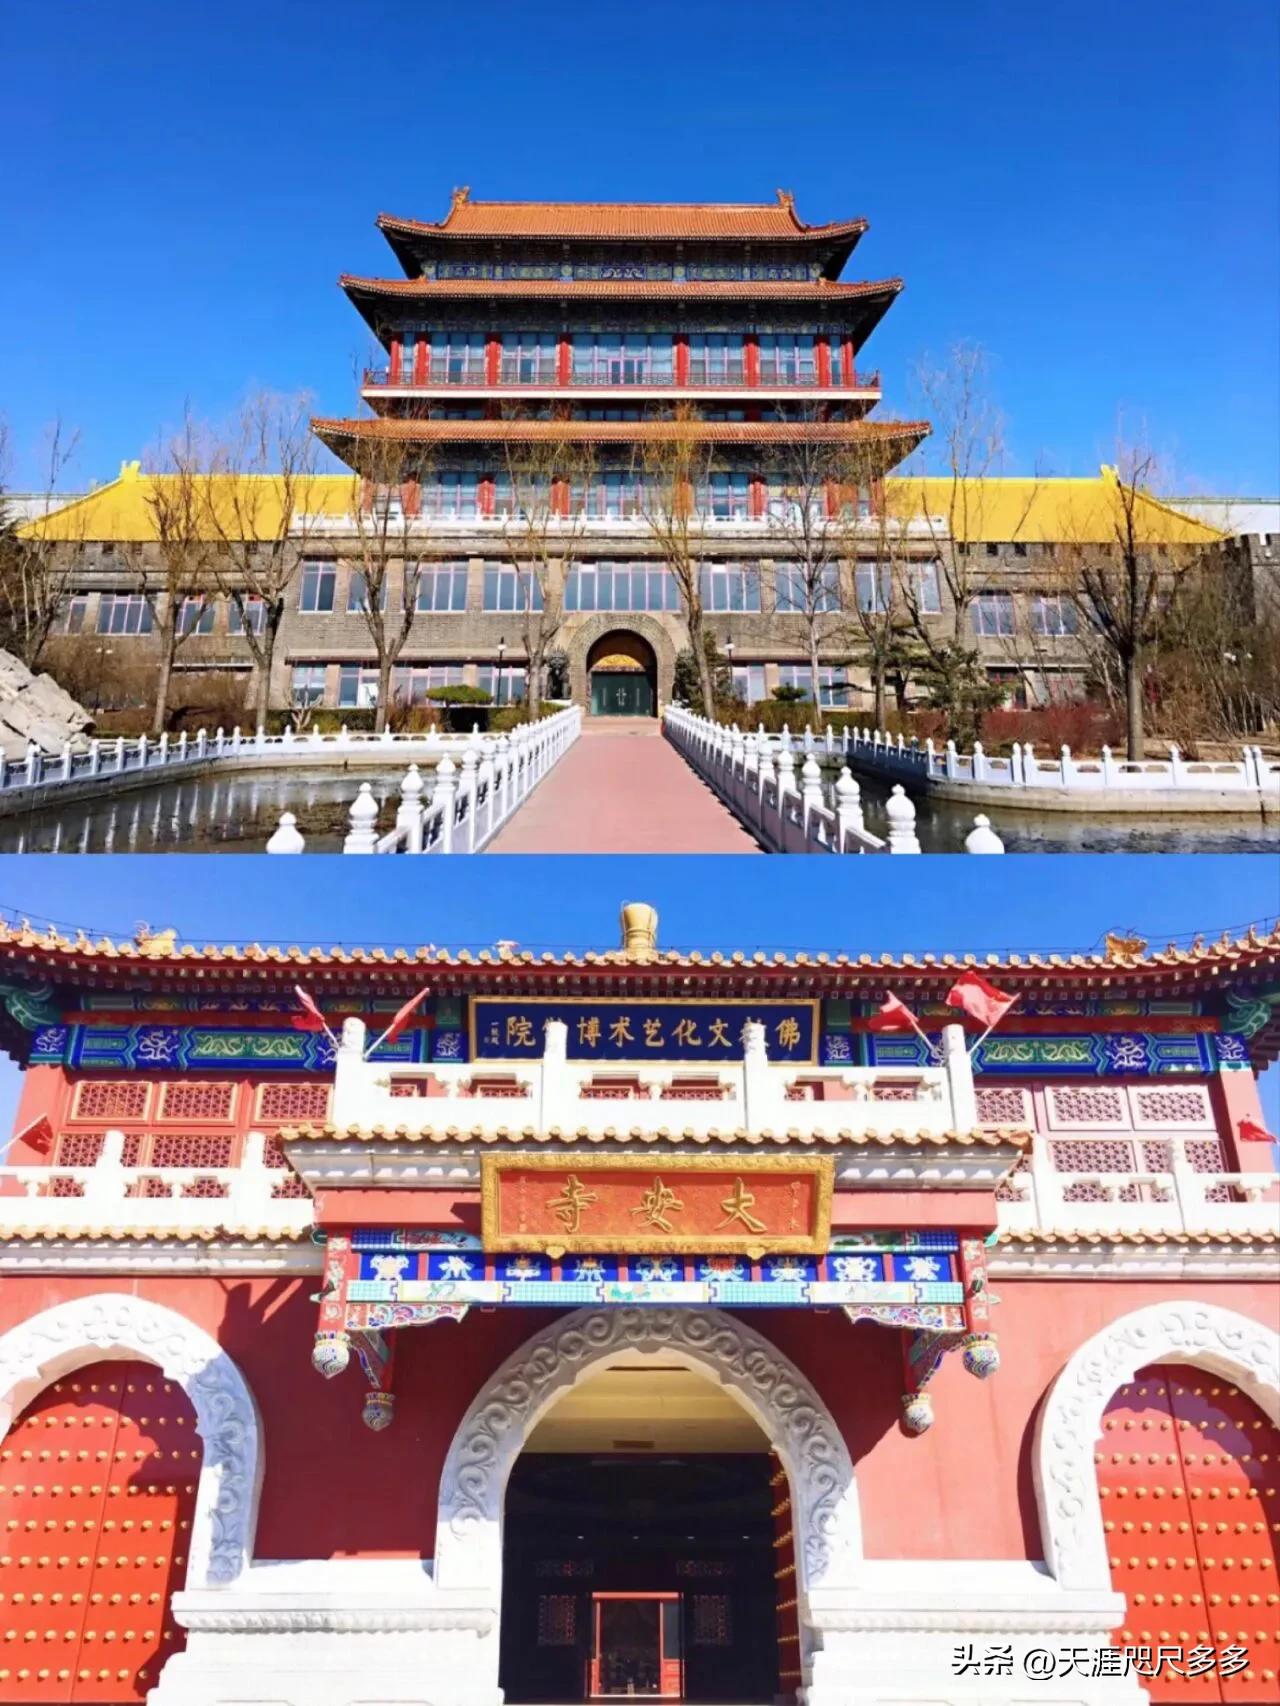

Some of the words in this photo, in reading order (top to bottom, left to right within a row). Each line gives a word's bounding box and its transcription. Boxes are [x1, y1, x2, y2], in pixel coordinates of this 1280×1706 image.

[506, 1015, 802, 1052] 佛文化艺术博院
[545, 1174, 768, 1233] 大安寺
